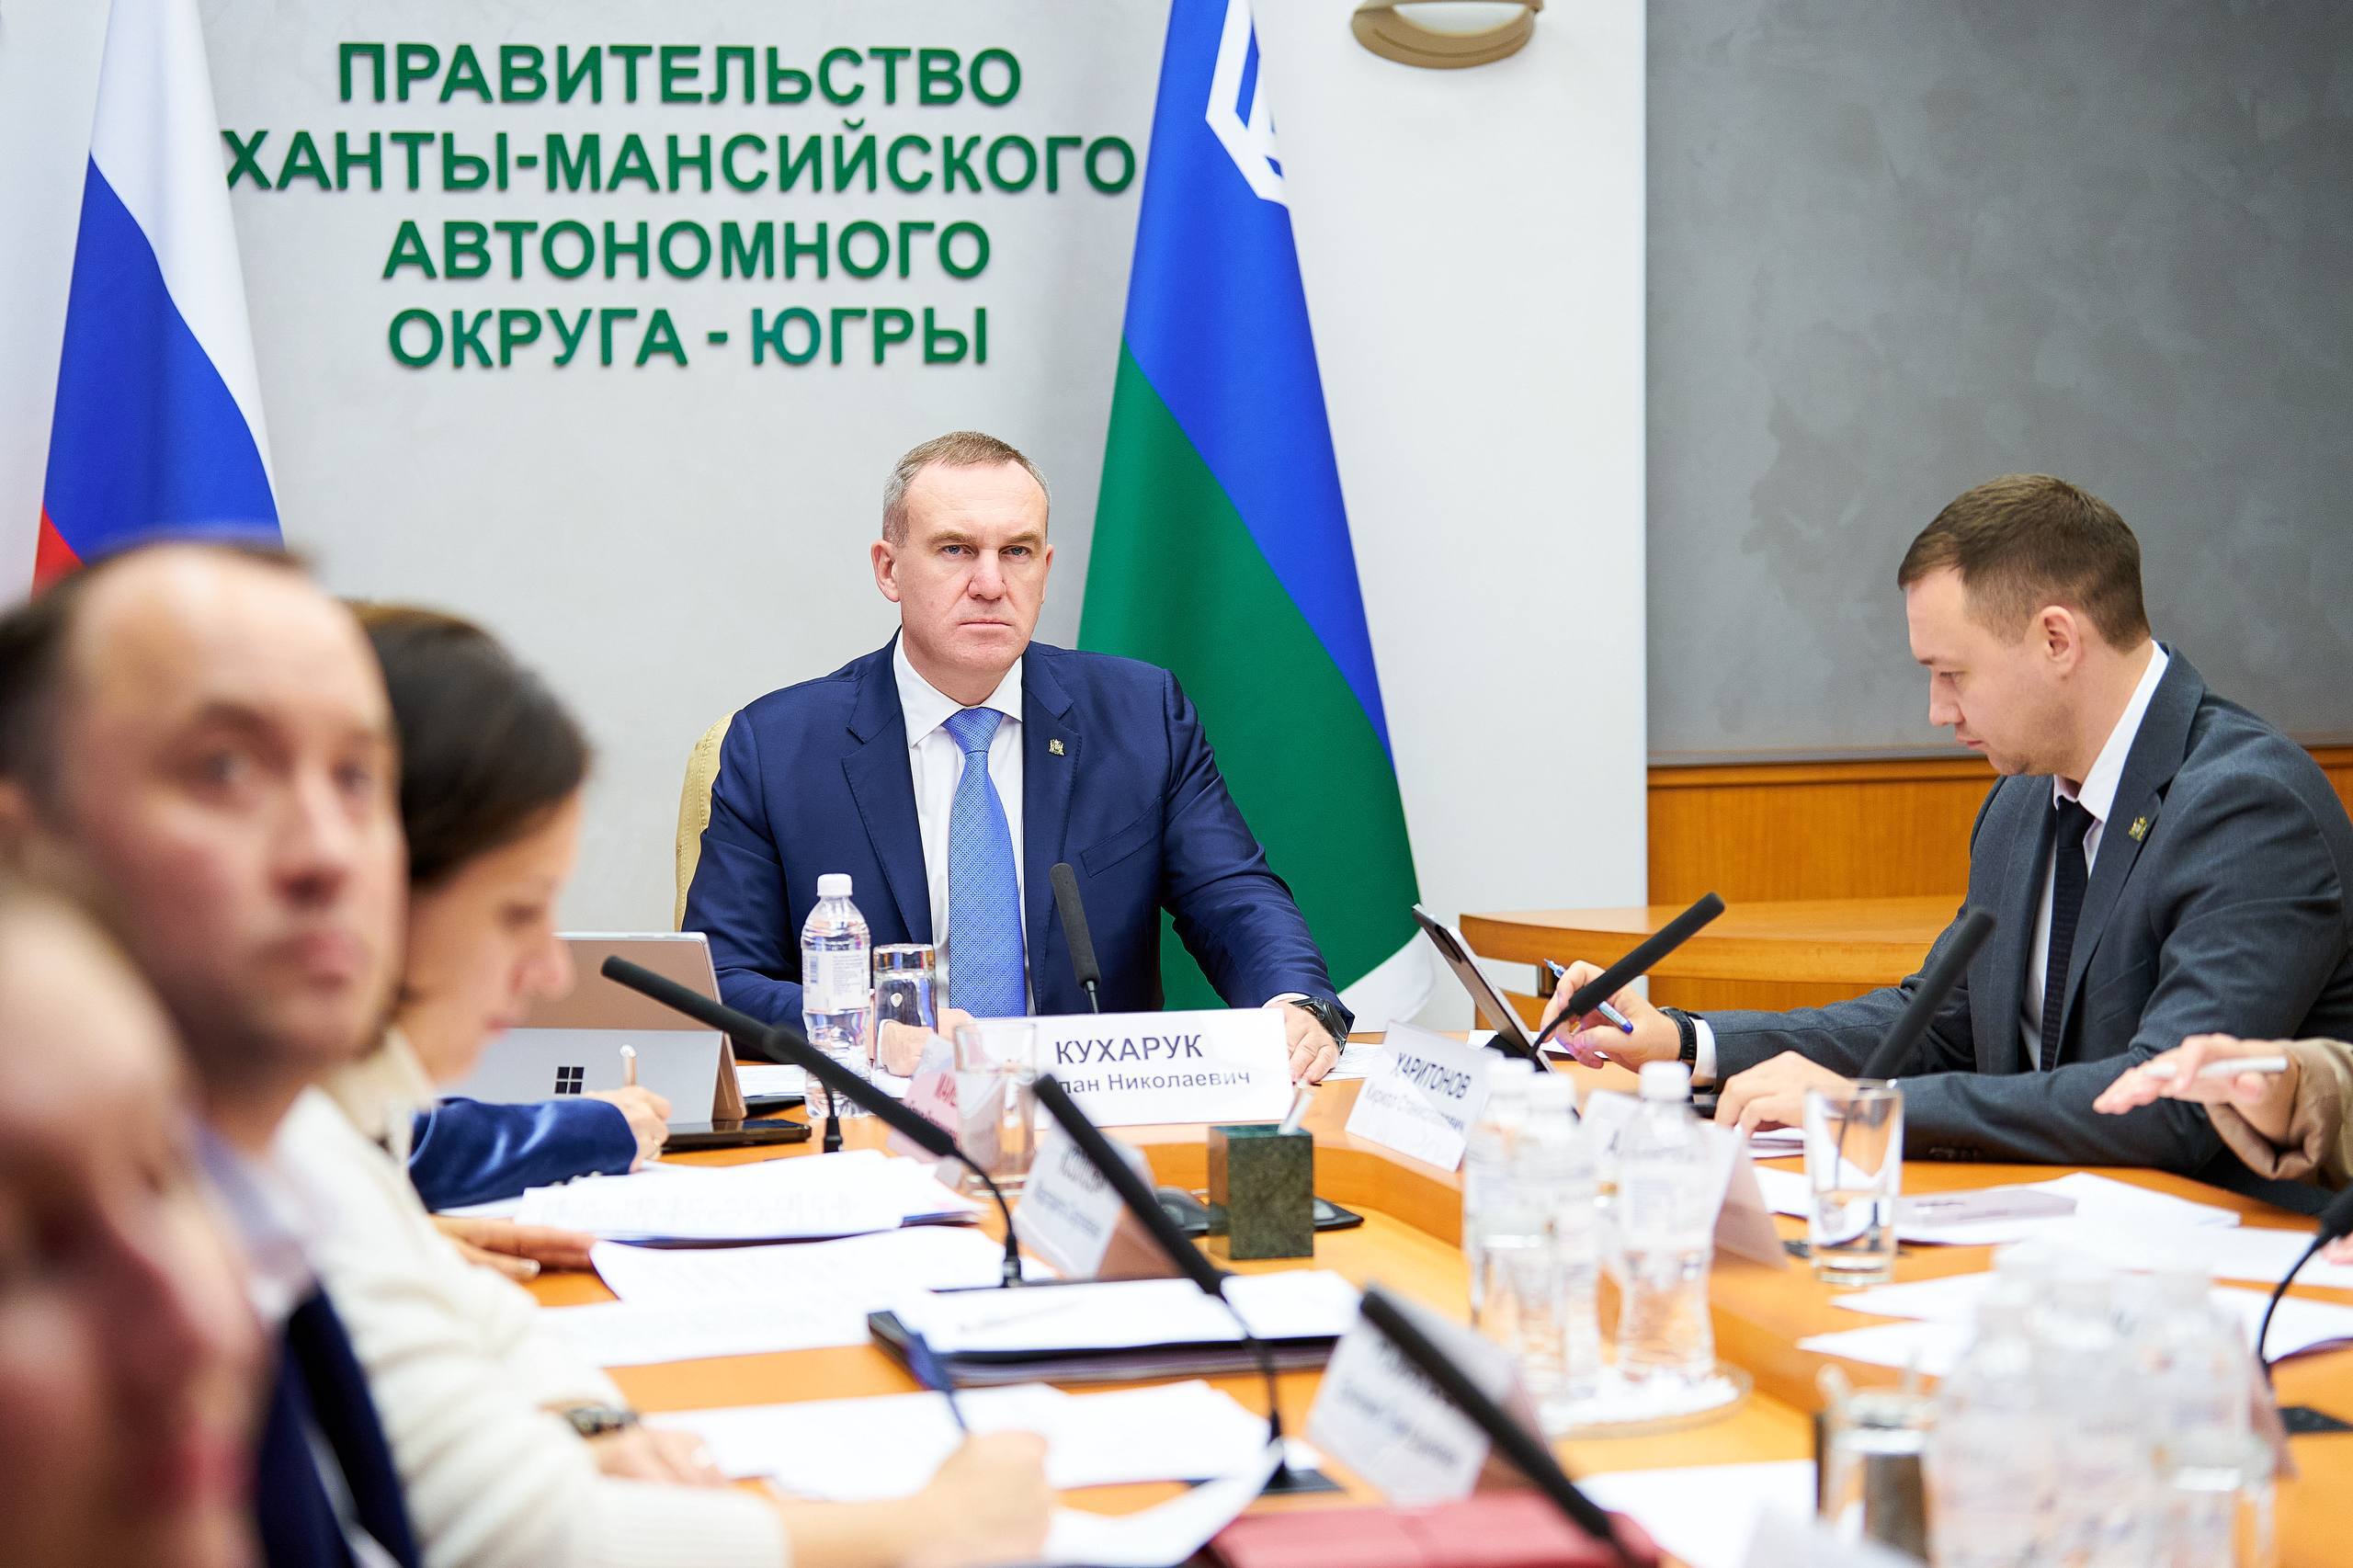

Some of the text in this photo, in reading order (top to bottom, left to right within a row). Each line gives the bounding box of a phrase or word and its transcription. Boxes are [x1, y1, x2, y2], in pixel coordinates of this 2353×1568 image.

[338, 42, 1022, 107] ПРАВИТЕЛЬСТВО
[222, 119, 1136, 193] ХАНТЫ-МАНСИЙСКОГО
[382, 220, 991, 279] АВТОНОМНОГО
[388, 308, 688, 368] ОКРУГА
[751, 306, 987, 366] ЮГРЫ
[1054, 1034, 1204, 1064] КУХАРУК
[1108, 1072, 1251, 1092] Николаевич
